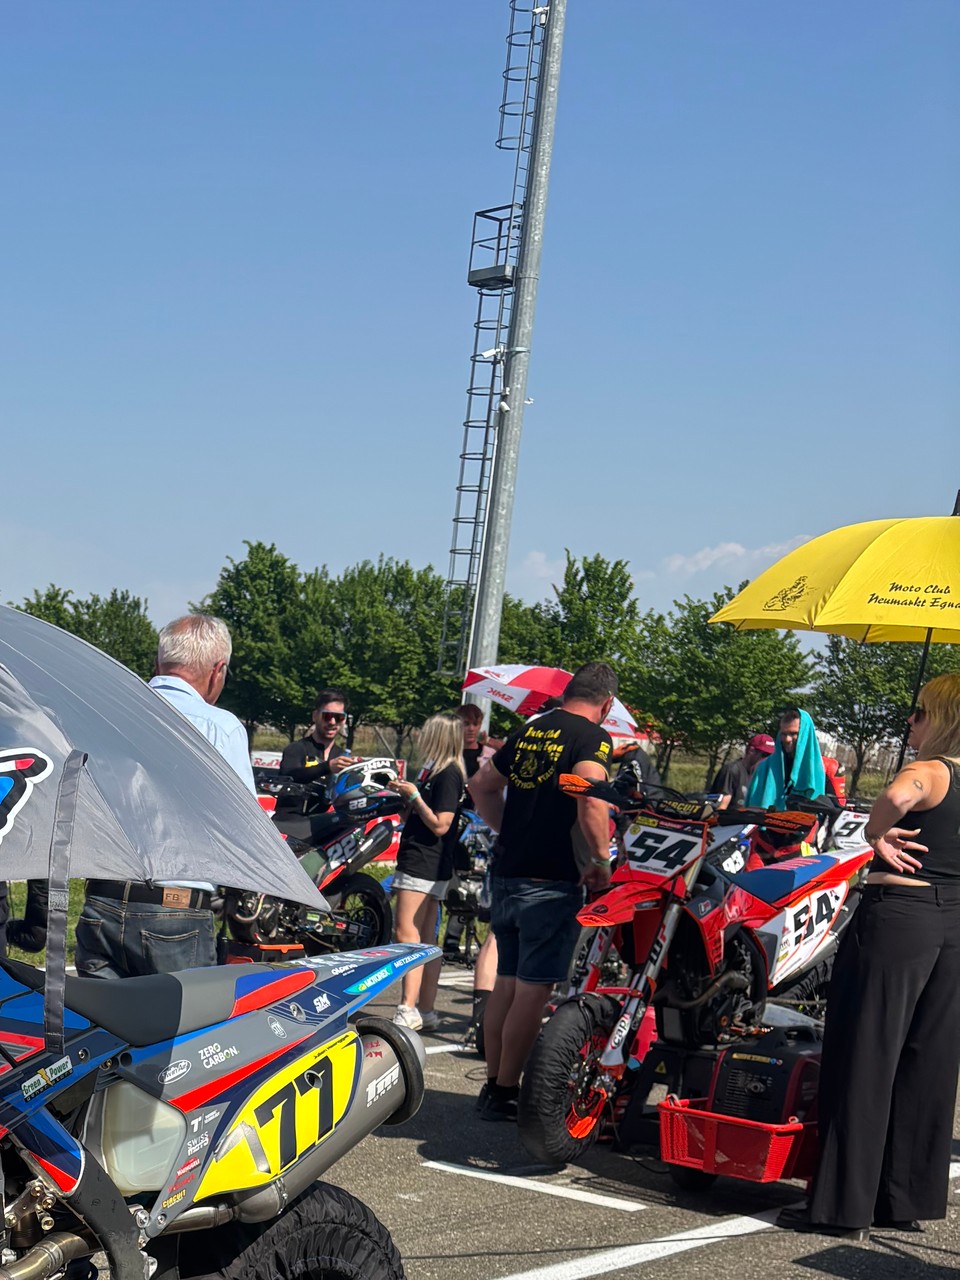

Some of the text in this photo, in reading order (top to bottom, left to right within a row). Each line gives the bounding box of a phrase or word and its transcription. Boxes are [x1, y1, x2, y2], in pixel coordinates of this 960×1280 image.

[889, 582, 950, 594] Moto Club
[867, 592, 926, 607] Neumarkt
[627, 831, 698, 870] 54
[722, 850, 745, 874] 93
[793, 892, 835, 946] 54
[393, 953, 421, 969] METZELER
[198, 1043, 221, 1060] ZERO
[23, 1061, 69, 1095] Green Power
[253, 1055, 334, 1171] 77
[187, 1131, 209, 1148] SWISS
[162, 1189, 187, 1208] CIRCUIT
